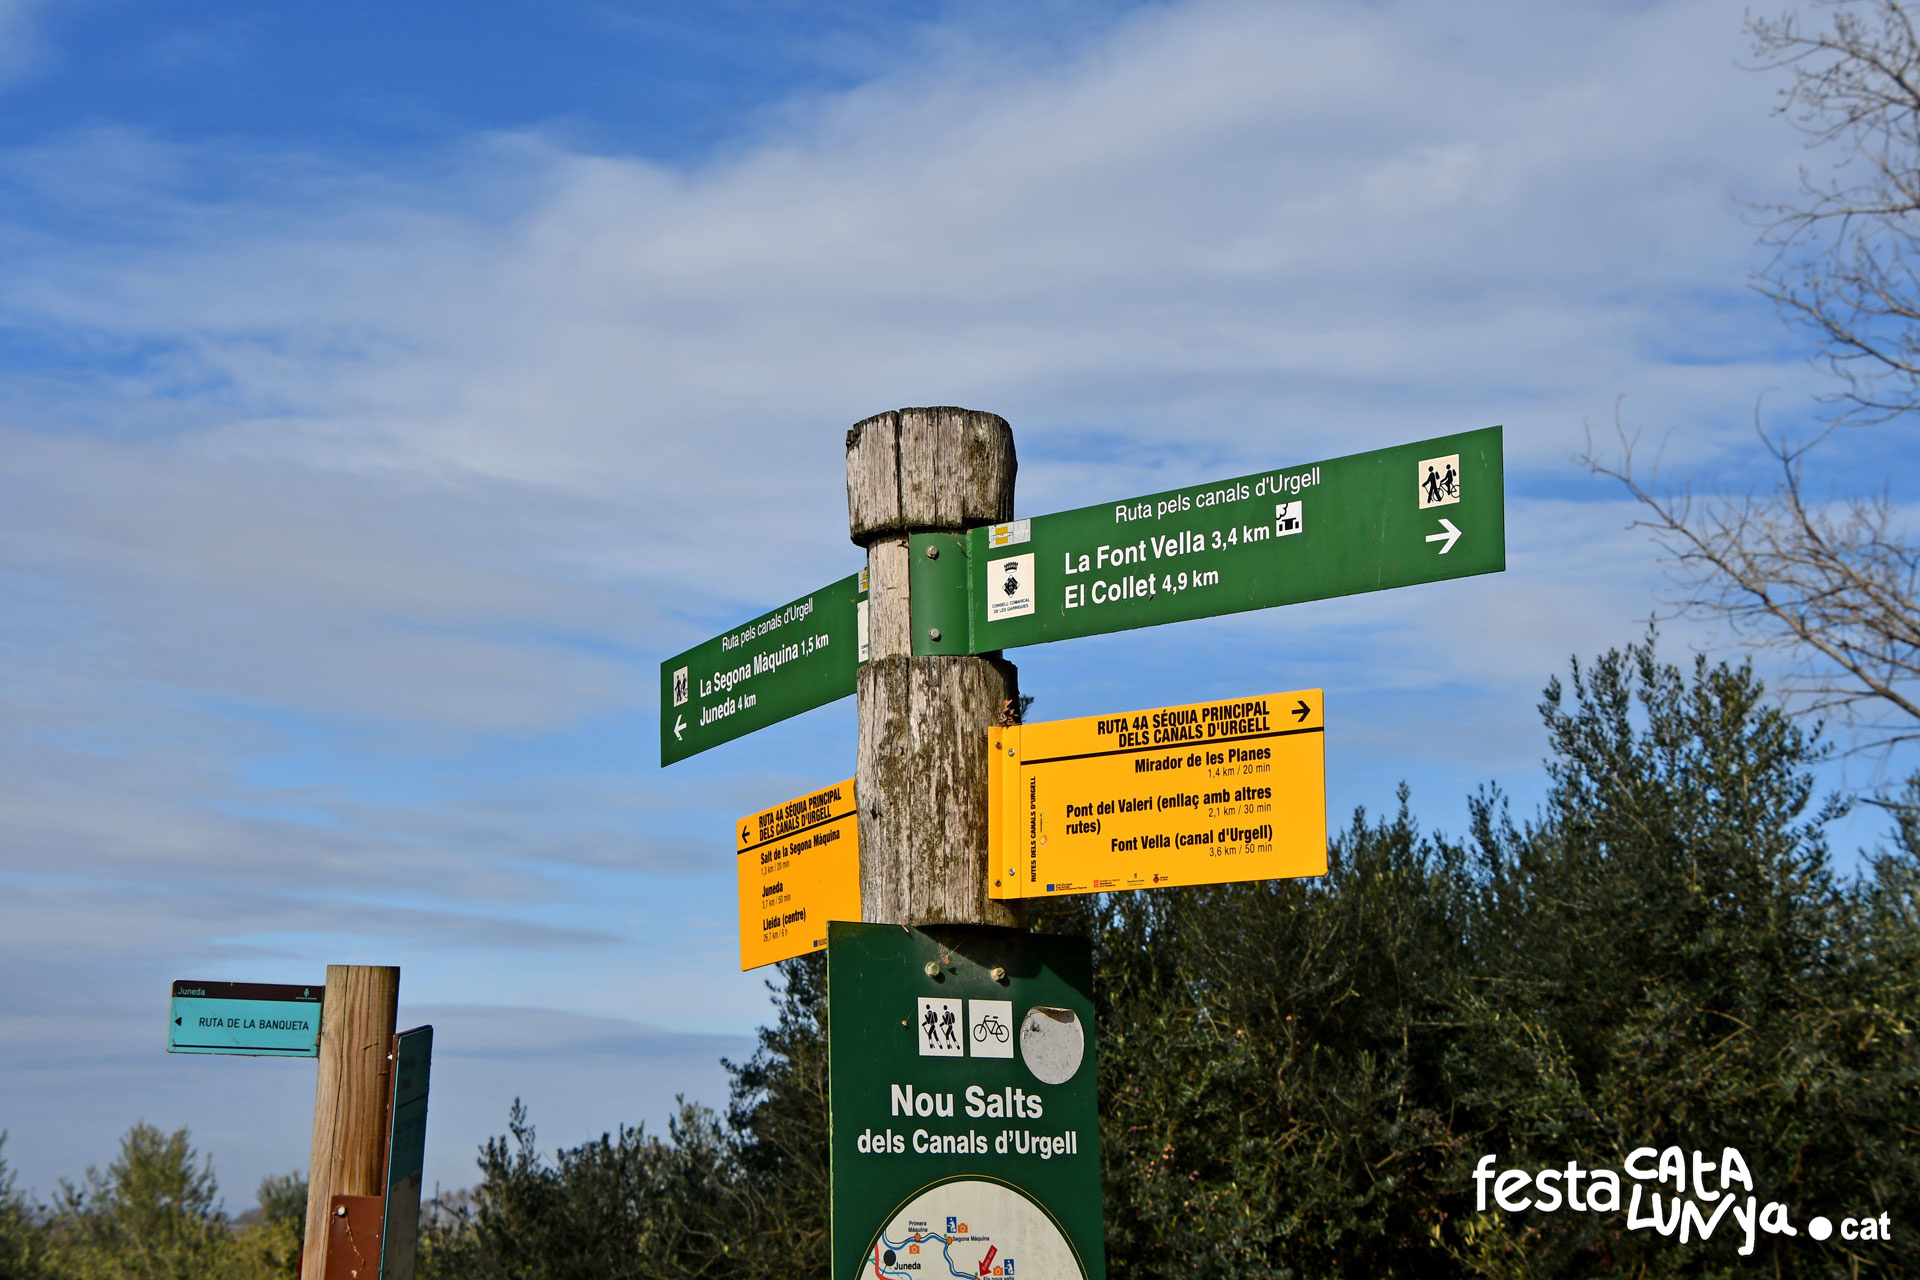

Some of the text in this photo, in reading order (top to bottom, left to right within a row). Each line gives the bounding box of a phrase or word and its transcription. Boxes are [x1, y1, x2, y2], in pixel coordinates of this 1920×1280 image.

[1115, 467, 1320, 523] Ruta pels canals d'Urgell
[1065, 524, 1270, 574] La Font Vella 3,4 km
[1065, 570, 1219, 609] El Collet 4,9 km
[722, 597, 813, 652] Ruta pels canals d'Urgell
[700, 632, 829, 698] La Segona Màquina 1,5 km
[700, 693, 757, 727] Juneda 4 km
[1097, 700, 1270, 735] RUTA 4A SÉQUIA PRINCIPAL
[1119, 716, 1270, 748] DELS CANALS D'URGELL
[1135, 747, 1271, 773] Mirador de les Planes
[1208, 768, 1220, 779] 1,4
[1223, 766, 1234, 776] km
[1243, 764, 1253, 774] 20
[1256, 764, 1270, 773] min
[759, 787, 842, 828] RUTA 4A SÉQUIA PRINCIPAL
[1066, 786, 1272, 818] Pont del Valeri (enllaç amb altres
[1209, 807, 1220, 817] 2,1
[1224, 806, 1235, 815] km
[1244, 804, 1254, 814] 30
[1257, 803, 1271, 813] min
[759, 805, 831, 842] DELS CANALS D'URGELL
[1066, 818, 1101, 835] rutes)
[761, 829, 840, 865] Salt de la Segona Màquina
[1111, 824, 1273, 852] Font Vella (canal d'Urgell)
[1210, 847, 1222, 857] 3,6
[1225, 846, 1236, 856] km
[1245, 844, 1255, 854] 50
[1258, 843, 1272, 852] min
[762, 881, 783, 898] Juneda
[778, 895, 783, 904] 50
[763, 907, 806, 931] Lleida (centre)
[773, 931, 778, 939] km
[177, 987, 205, 996] Juneda
[199, 1018, 309, 1030] RUTA DE LA BANQUETA
[891, 1084, 1043, 1119] Nou Salts
[857, 1128, 905, 1154] dels
[912, 1128, 988, 1155] Canals
[894, 1262, 921, 1270] Juneda
